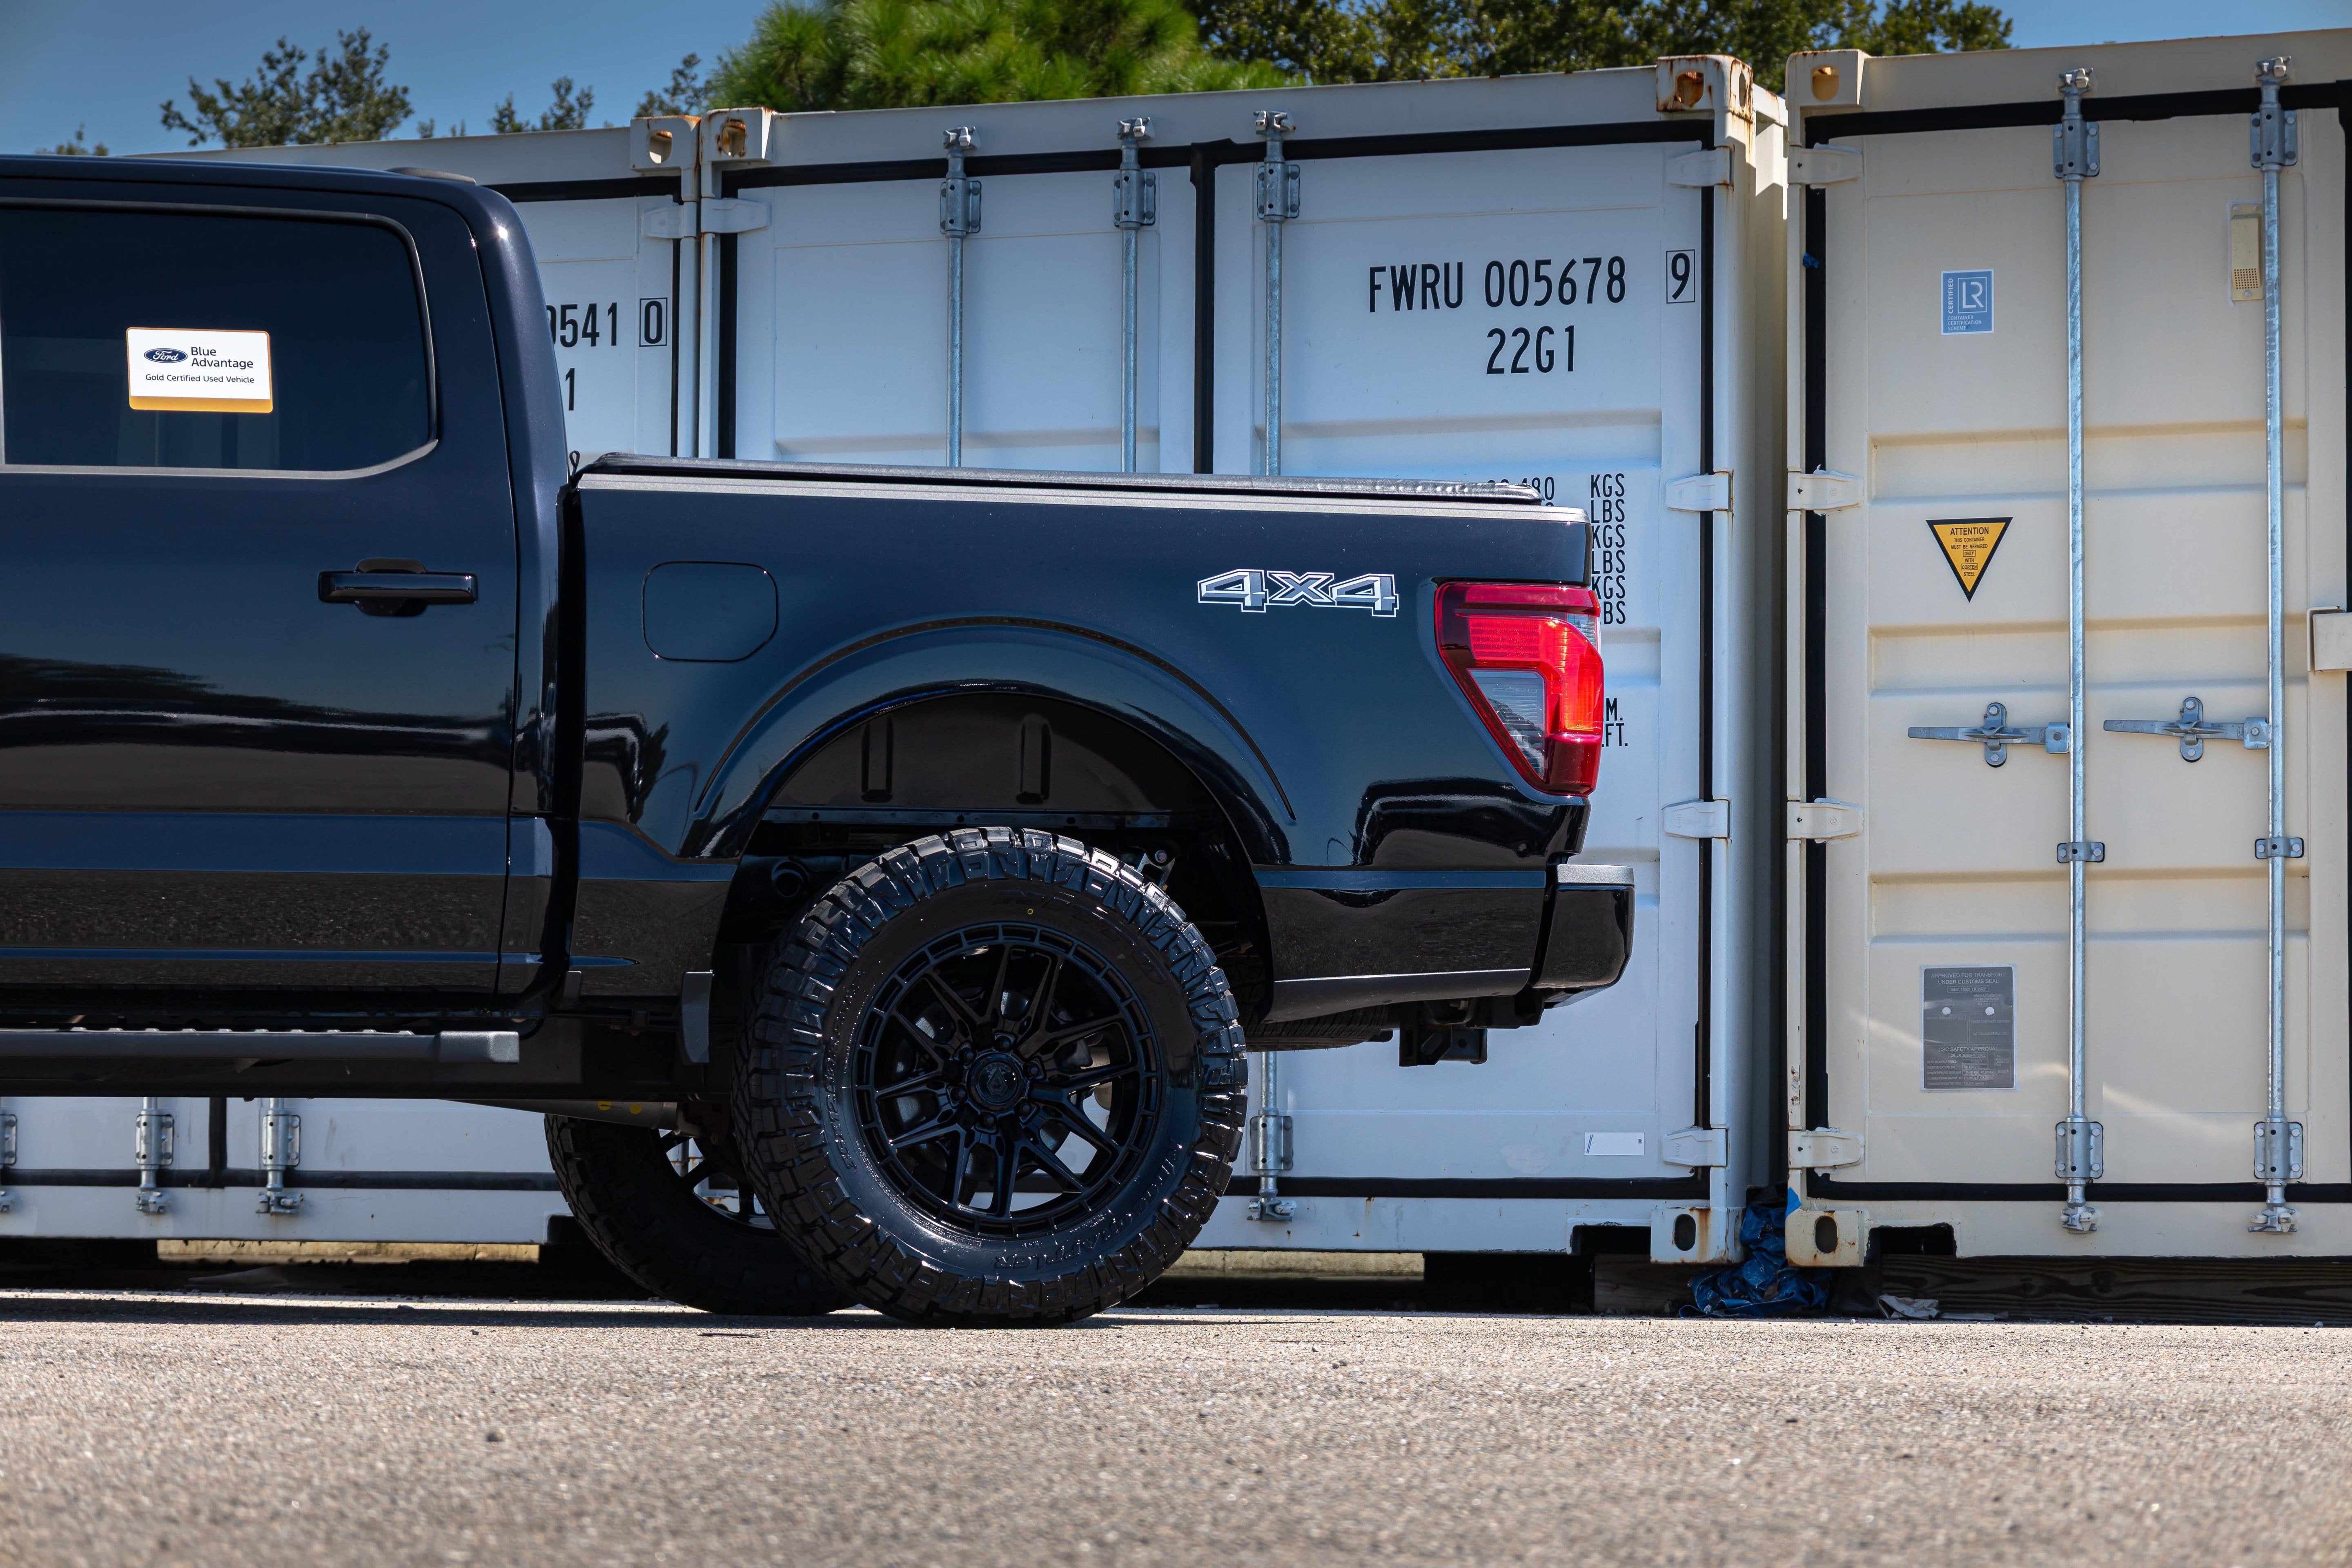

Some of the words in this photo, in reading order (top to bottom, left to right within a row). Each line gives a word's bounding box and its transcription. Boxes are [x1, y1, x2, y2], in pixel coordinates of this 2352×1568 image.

[1370, 261, 1463, 313] FWRU
[1485, 256, 1626, 307] 005678
[1671, 252, 1690, 300] 9
[1962, 282, 1984, 308] LR
[644, 301, 662, 344] 0
[153, 350, 178, 361] Ford
[191, 347, 216, 356] Blue
[1486, 325, 1575, 374] 22G1
[192, 358, 253, 370] Advantage
[1591, 473, 1625, 498] KGS
[1591, 499, 1625, 523] LBS
[1592, 524, 1625, 548] KGS
[1950, 527, 1989, 535] ATTENTION
[1592, 550, 1625, 574] LBS
[1592, 575, 1626, 599] KGS
[1600, 601, 1626, 625] BS
